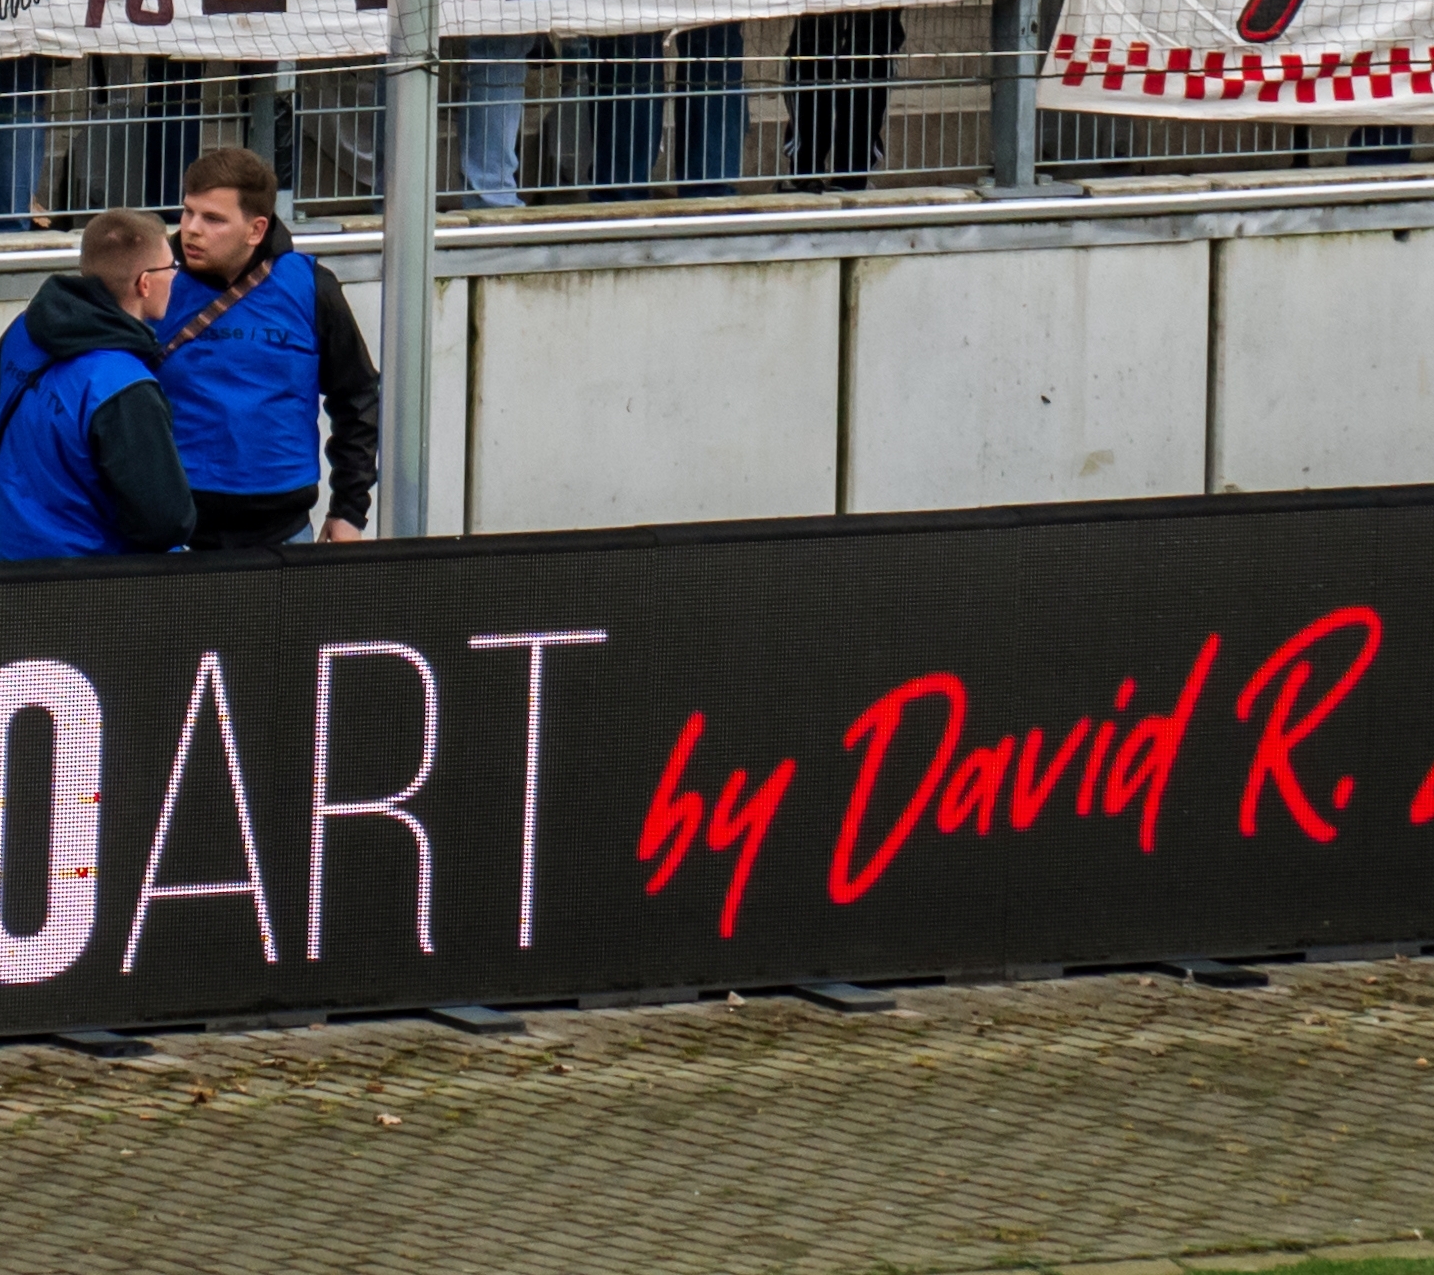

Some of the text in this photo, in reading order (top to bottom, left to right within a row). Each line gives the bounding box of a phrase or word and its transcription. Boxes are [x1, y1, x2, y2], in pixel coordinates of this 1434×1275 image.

[262, 327, 290, 344] TV
[636, 711, 796, 940] by
[826, 631, 1221, 905] David
[1233, 606, 1382, 843] R.
